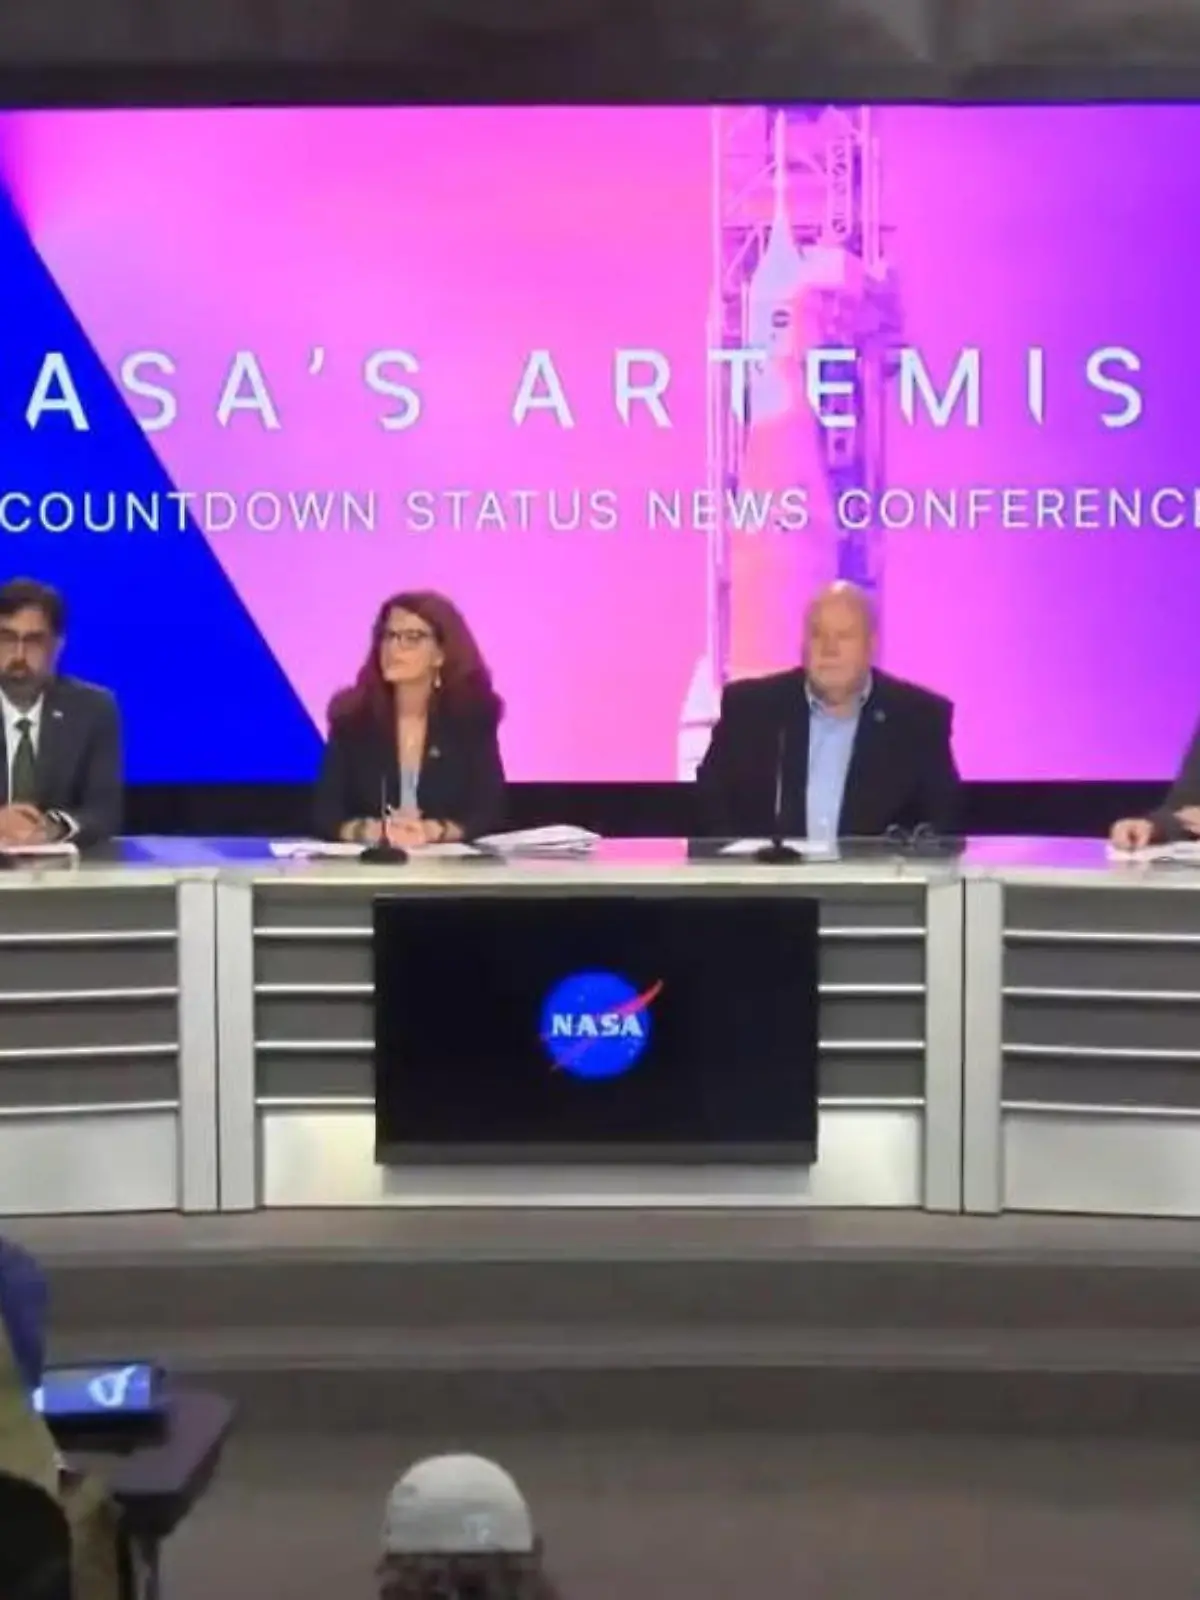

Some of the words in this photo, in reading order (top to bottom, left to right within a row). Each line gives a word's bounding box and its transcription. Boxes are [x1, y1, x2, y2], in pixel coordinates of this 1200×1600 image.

[512, 347, 1143, 429] ARTEMIS
[0, 491, 377, 532] COUNTDOWN
[407, 489, 617, 530] STATUS
[649, 489, 808, 530] NEWS
[838, 487, 1200, 530] CONFERENC
[551, 1013, 643, 1037] NASA
